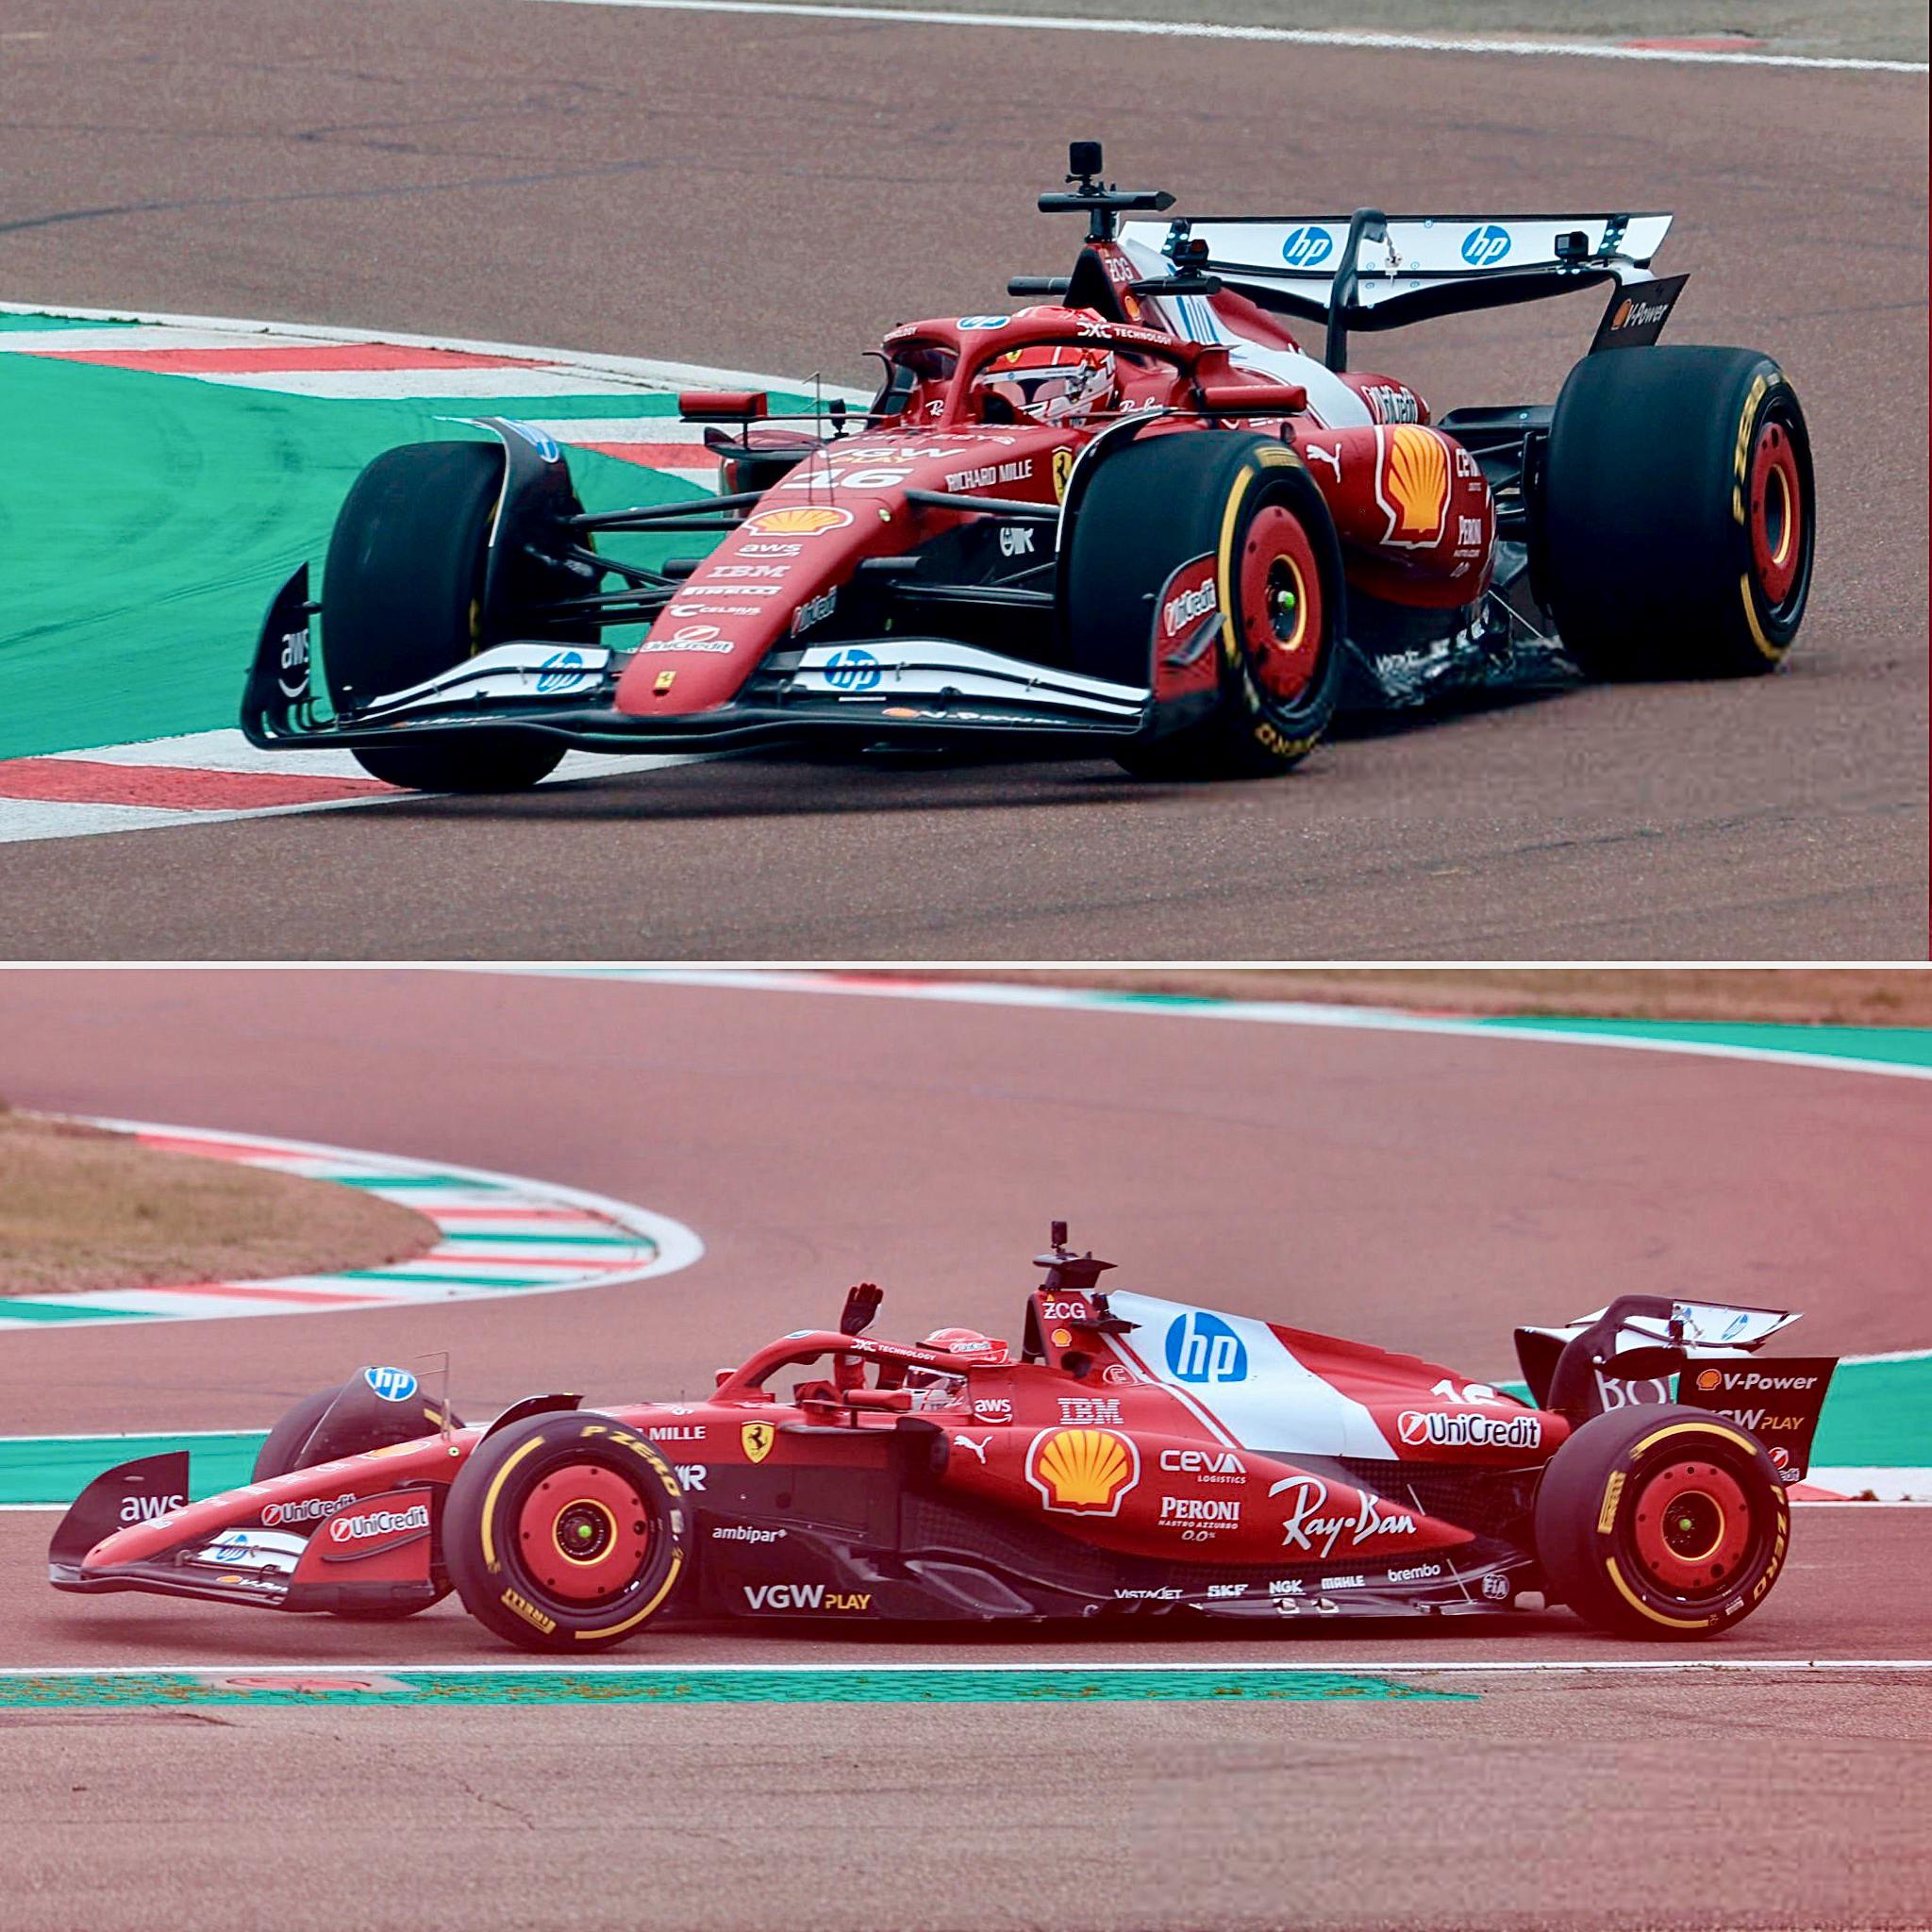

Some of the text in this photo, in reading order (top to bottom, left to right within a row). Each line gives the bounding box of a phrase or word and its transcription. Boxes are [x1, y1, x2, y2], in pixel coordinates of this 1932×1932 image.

[1285, 226, 1331, 266] hp
[1464, 225, 1510, 266] hp
[1105, 258, 1133, 283] ZCG
[1076, 322, 1173, 346] DXC TECHNOLOGY
[781, 468, 914, 490] 16
[945, 458, 1033, 492] RICHARD MILLE
[739, 543, 803, 554] aws
[707, 565, 791, 578] IBM
[1041, 1302, 1086, 1320] ZCG
[851, 1338, 937, 1361] DXC TECHNOLOGY
[1173, 1311, 1241, 1383] hp
[372, 1367, 413, 1401] hp
[1724, 1373, 1818, 1391] V-Power
[974, 1398, 1012, 1413] aws
[1057, 1397, 1124, 1425] IBM
[1429, 1413, 1541, 1448] UniCredit
[1710, 1408, 1805, 1430] GW PLAY
[648, 1425, 708, 1441] MILLE
[1197, 1474, 1246, 1484] LOGISTICS
[120, 1494, 185, 1522] aws
[1160, 1496, 1241, 1521] PERONI
[1269, 1475, 1416, 1557] Ray-Ban
[351, 1505, 430, 1539] UniCredit
[712, 1525, 779, 1544] ambipar
[1322, 1574, 1366, 1591] MAHLE
[1388, 1563, 1441, 1583] brembo
[743, 1584, 872, 1610] VGW PLAY
[1207, 1584, 1249, 1598] SKF
[1269, 1579, 1304, 1593] NGK
